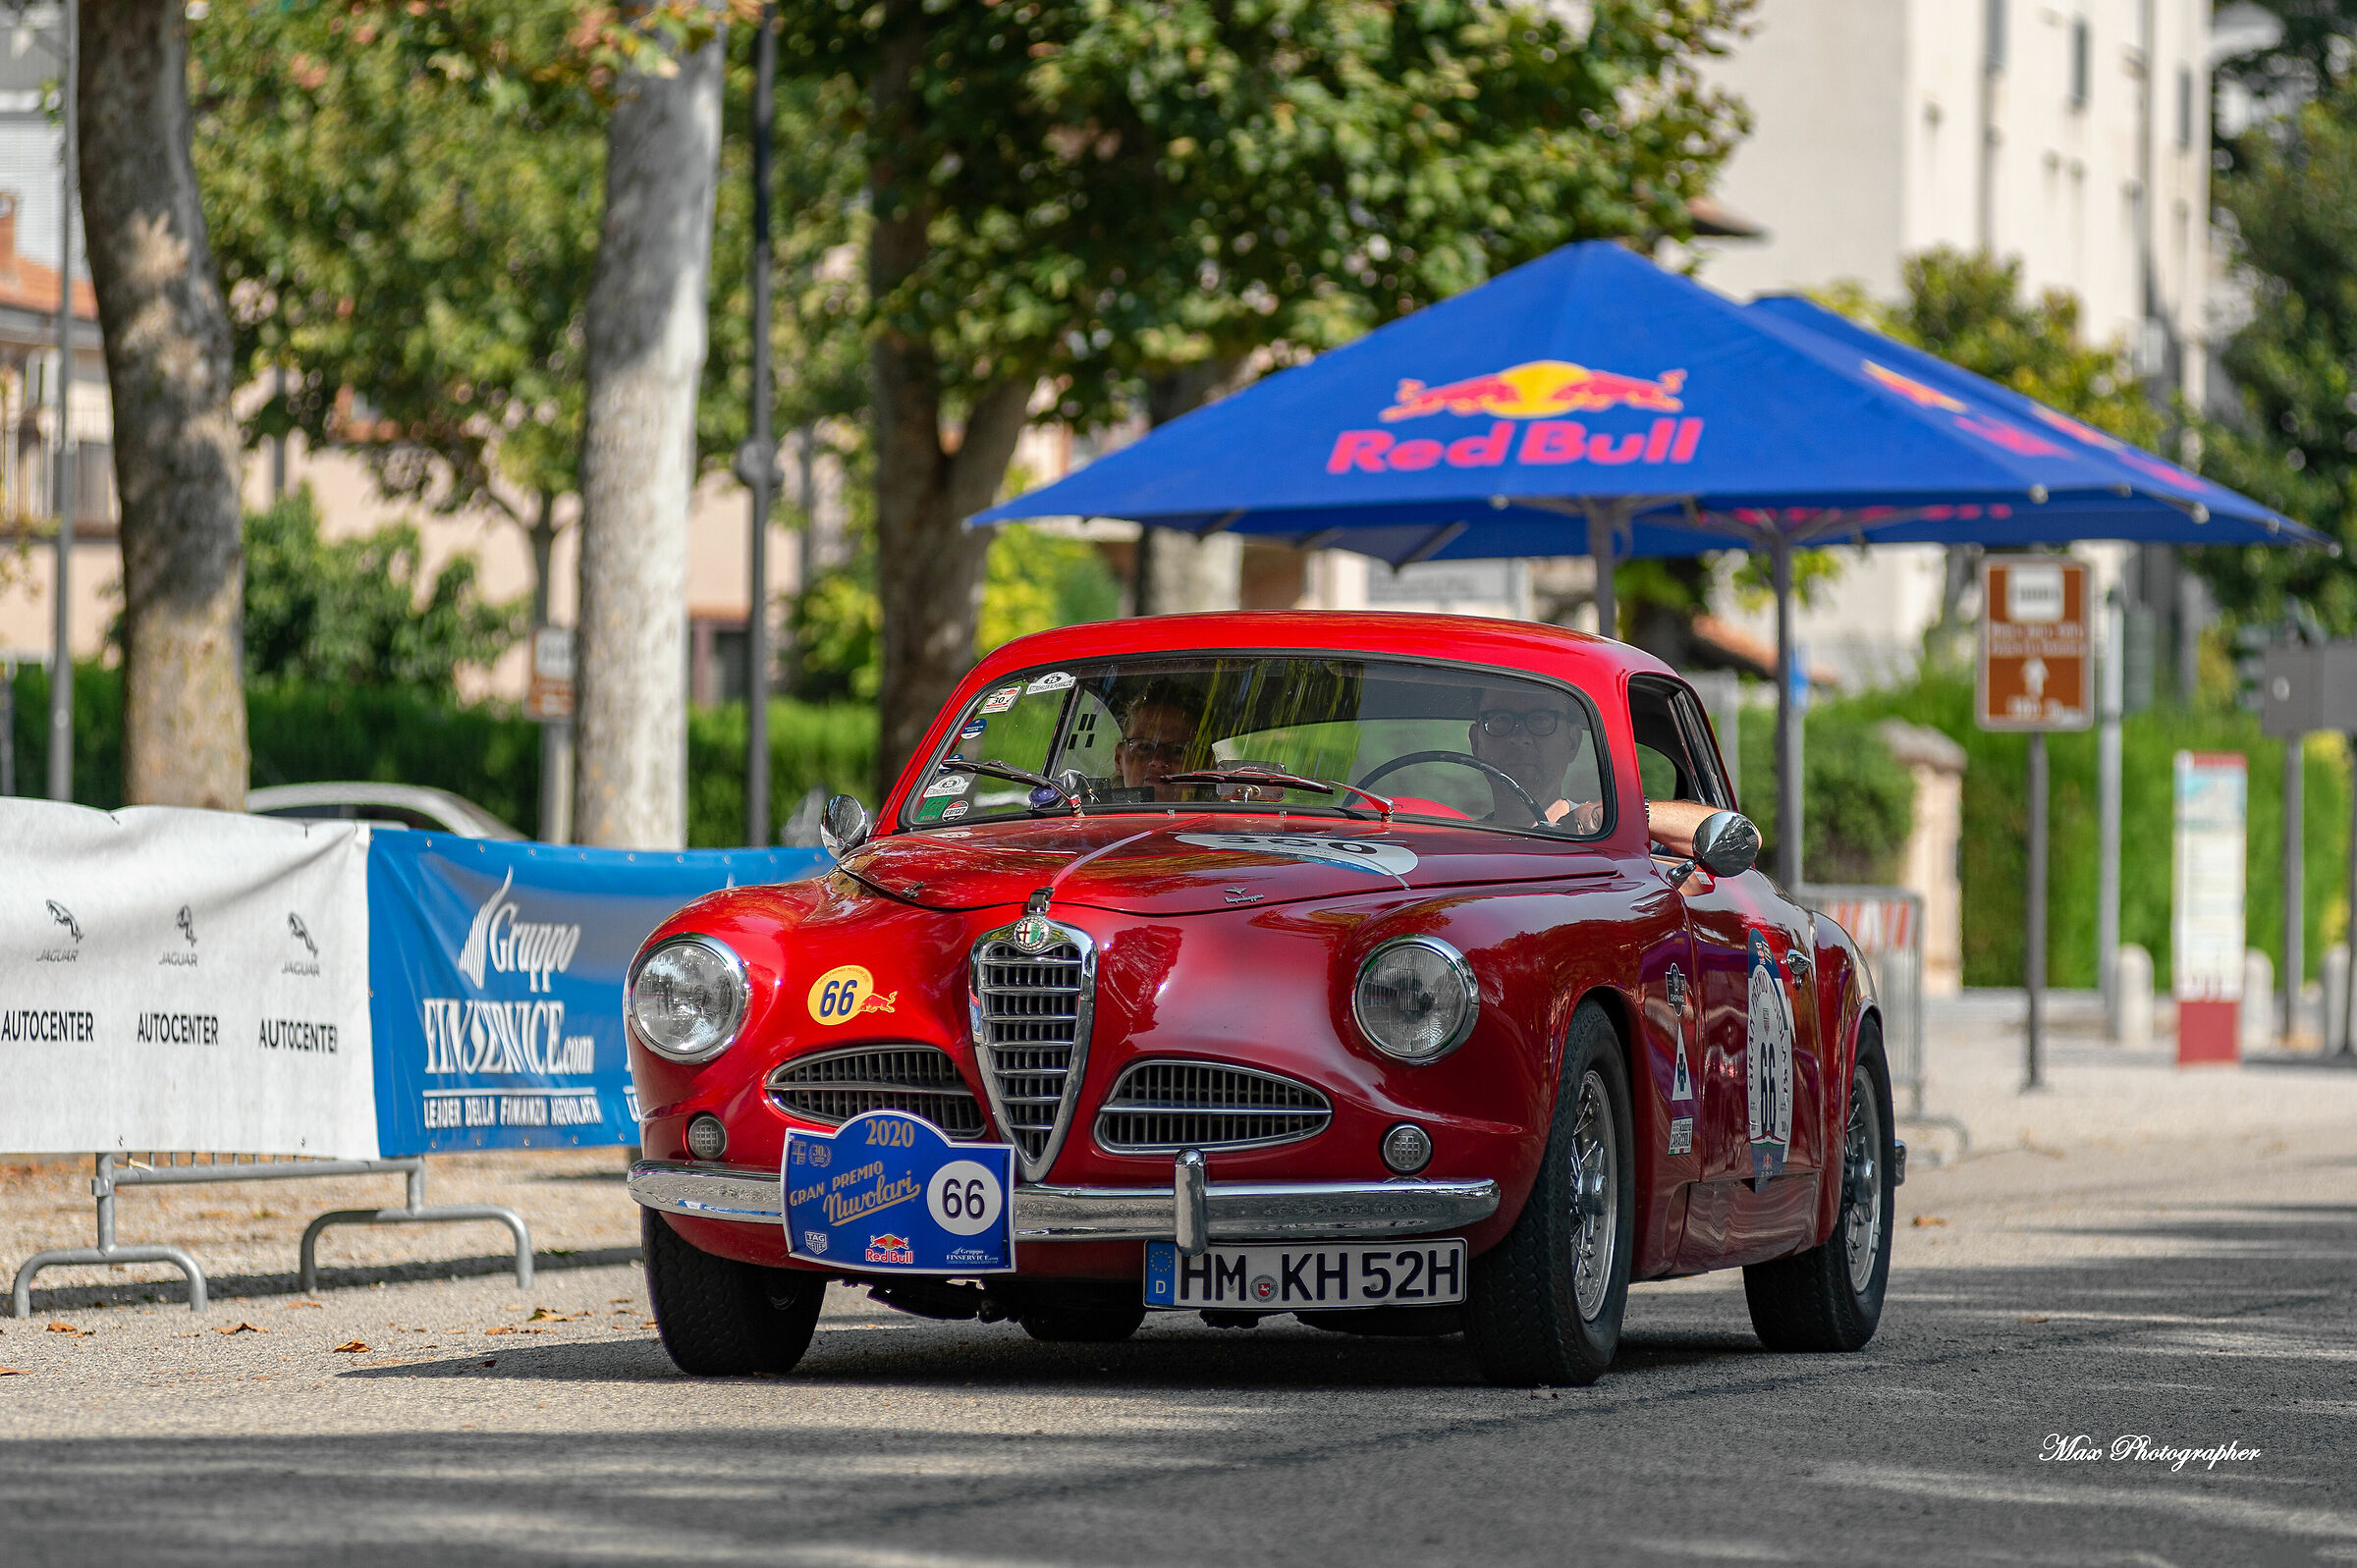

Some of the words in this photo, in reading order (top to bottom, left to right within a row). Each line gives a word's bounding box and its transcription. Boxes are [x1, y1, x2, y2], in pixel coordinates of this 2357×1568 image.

[1326, 419, 1516, 475] Red
[1517, 417, 1705, 467] Bull
[36, 948, 80, 963] JAGUAR
[158, 951, 199, 967] JAGUAR
[489, 901, 582, 994] Gruppo
[281, 960, 321, 977] JAGUAR
[819, 979, 858, 1018] 66
[1, 1009, 95, 1043] AUTOCENTER
[137, 1012, 220, 1047] AUTOCENTER
[1761, 1042, 1776, 1140] 66
[423, 1097, 463, 1130] LEADER
[465, 1097, 497, 1127] DELLA
[500, 1096, 549, 1127] FINANZA
[865, 1118, 915, 1148] 2020
[790, 1181, 825, 1207] GRAN
[832, 1161, 884, 1191] PREMIO
[822, 1169, 921, 1226] Nuvolari
[942, 1177, 985, 1219] 66
[806, 1233, 825, 1242] TAG
[865, 1248, 888, 1264] Red
[889, 1249, 913, 1265] Bull
[1155, 1279, 1166, 1294] D
[1180, 1252, 1246, 1301] HM
[1281, 1252, 1348, 1301] KH
[1362, 1248, 1459, 1299] 52H
